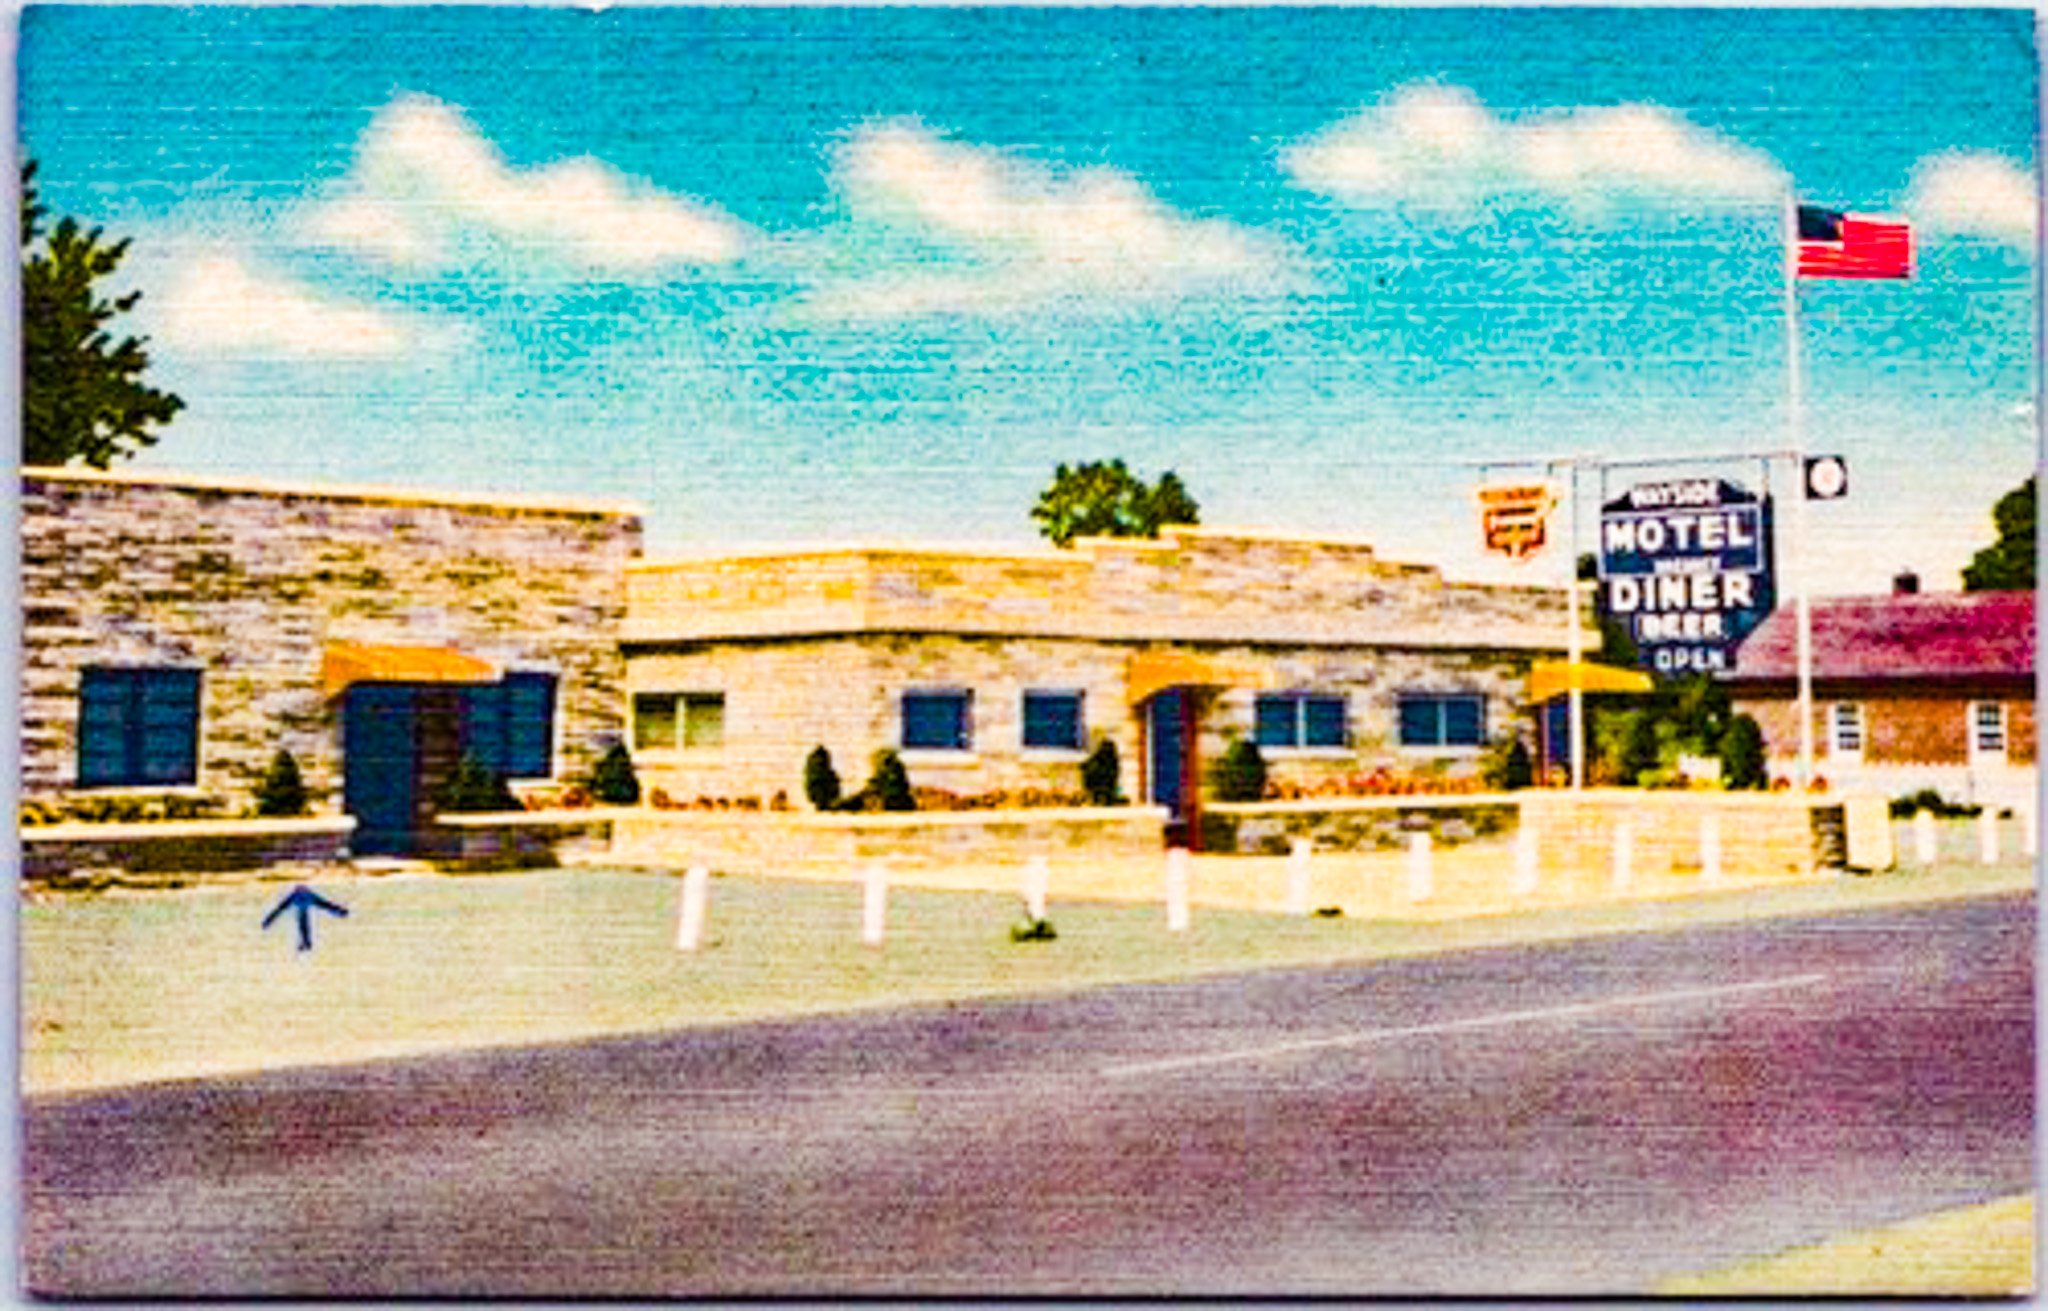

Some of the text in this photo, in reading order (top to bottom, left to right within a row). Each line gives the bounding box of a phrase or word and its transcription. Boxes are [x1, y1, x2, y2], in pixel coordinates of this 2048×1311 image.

[1606, 515, 1754, 553] MOTEL
[1611, 573, 1754, 612] DINER
[1640, 613, 1725, 639] BEER
[1654, 647, 1725, 671] OPEN
